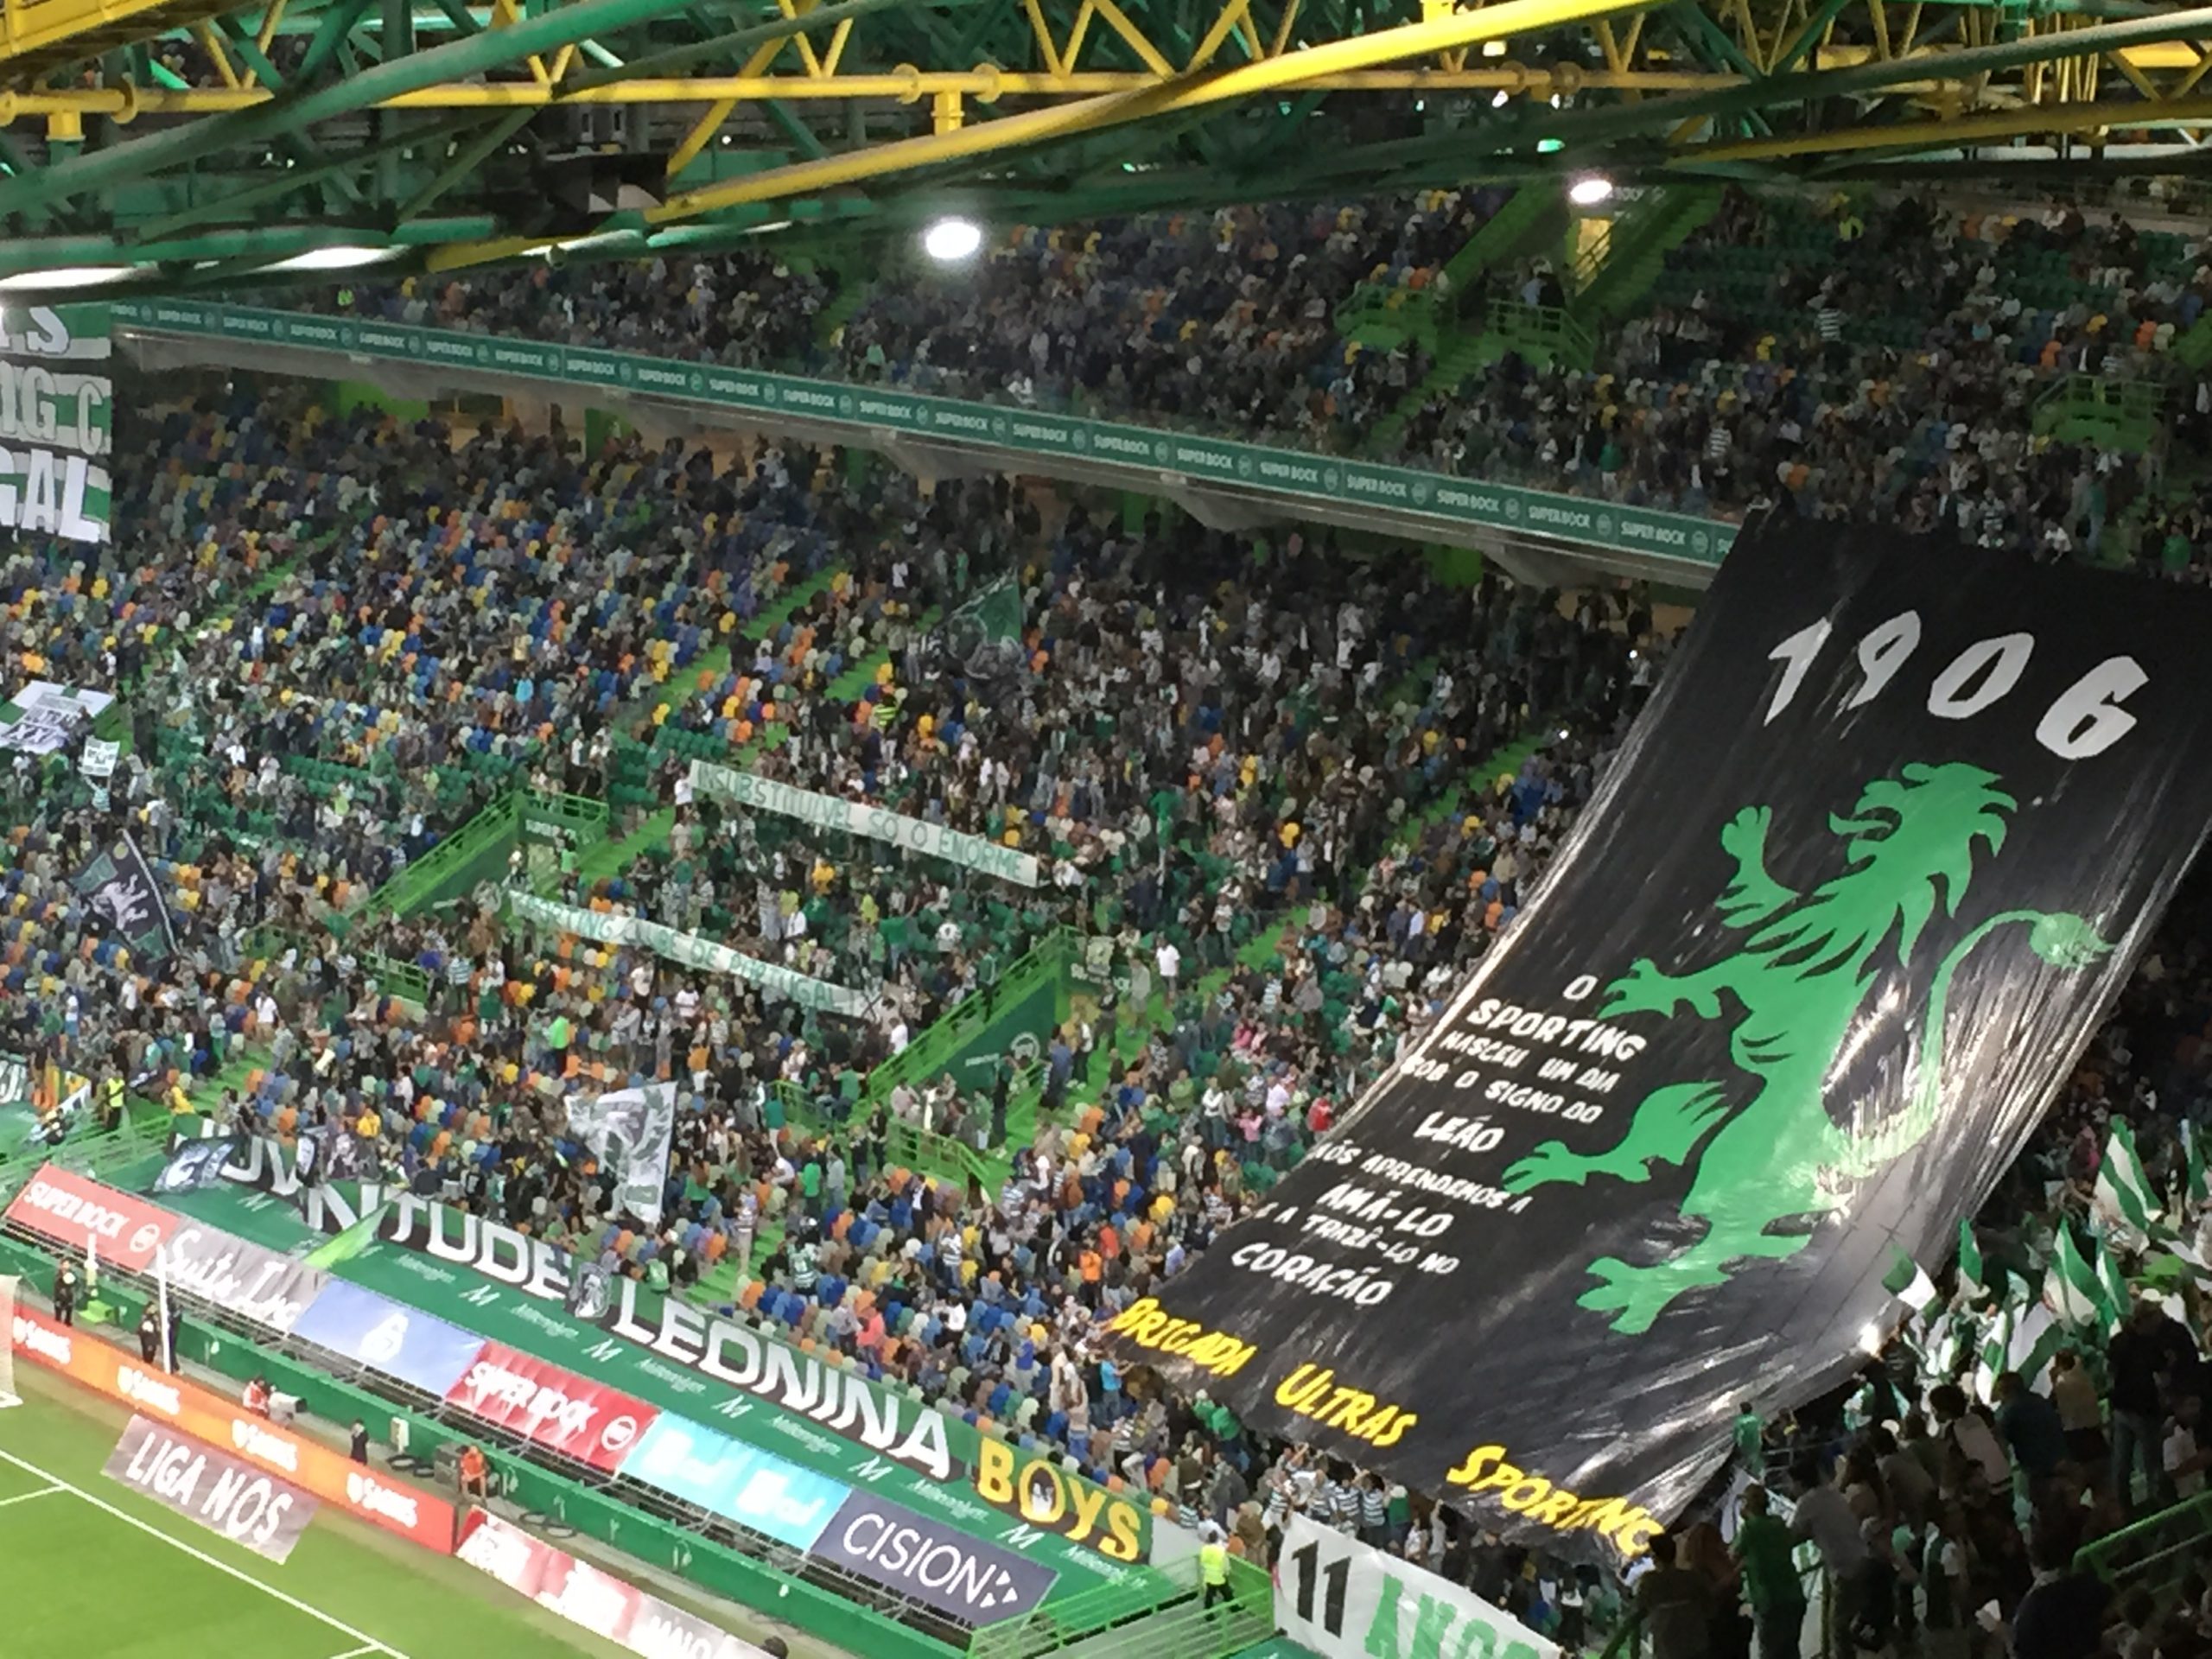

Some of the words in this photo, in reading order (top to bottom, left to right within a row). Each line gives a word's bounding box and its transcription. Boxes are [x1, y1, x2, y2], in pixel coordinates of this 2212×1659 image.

[1621, 521, 1654, 539] SUPER
[1656, 528, 1686, 545] BOCK
[1764, 610, 2150, 760] 1906
[1562, 974, 1599, 1001] O
[1466, 998, 1648, 1061] SPORTING
[1439, 1030, 1530, 1068] NASCEU
[1537, 1058, 1579, 1082] UM
[1575, 1067, 1621, 1094] DIA
[1454, 1071, 1480, 1089] O
[1484, 1080, 1565, 1113] SIGNO
[1561, 1100, 1604, 1124] DO
[1414, 1111, 1505, 1153] LEÃO
[24, 1181, 78, 1218] SUPER
[73, 1198, 130, 1239] BOCK
[1315, 1182, 1455, 1237] AMÁ-LO
[1359, 1154, 1511, 1209] APRENDEMOS
[1508, 1195, 1534, 1214] A
[1274, 1206, 1299, 1224] A
[1300, 1214, 1421, 1264] TRAZÊ-LO
[1417, 1252, 1460, 1274] NO
[1230, 1242, 1394, 1309] CORAÇÃO
[611, 1277, 950, 1481] LEONINA
[976, 1436, 1142, 1562] BOYS
[1112, 1297, 1258, 1376] BRIGADA
[1274, 1362, 1418, 1447] ULTRAS
[1446, 1445, 1666, 1557] SPORTNG
[126, 1431, 207, 1506] LIGA
[200, 1466, 294, 1543] NOS
[843, 1513, 996, 1608] CISION
[1292, 1540, 1351, 1639] 11
